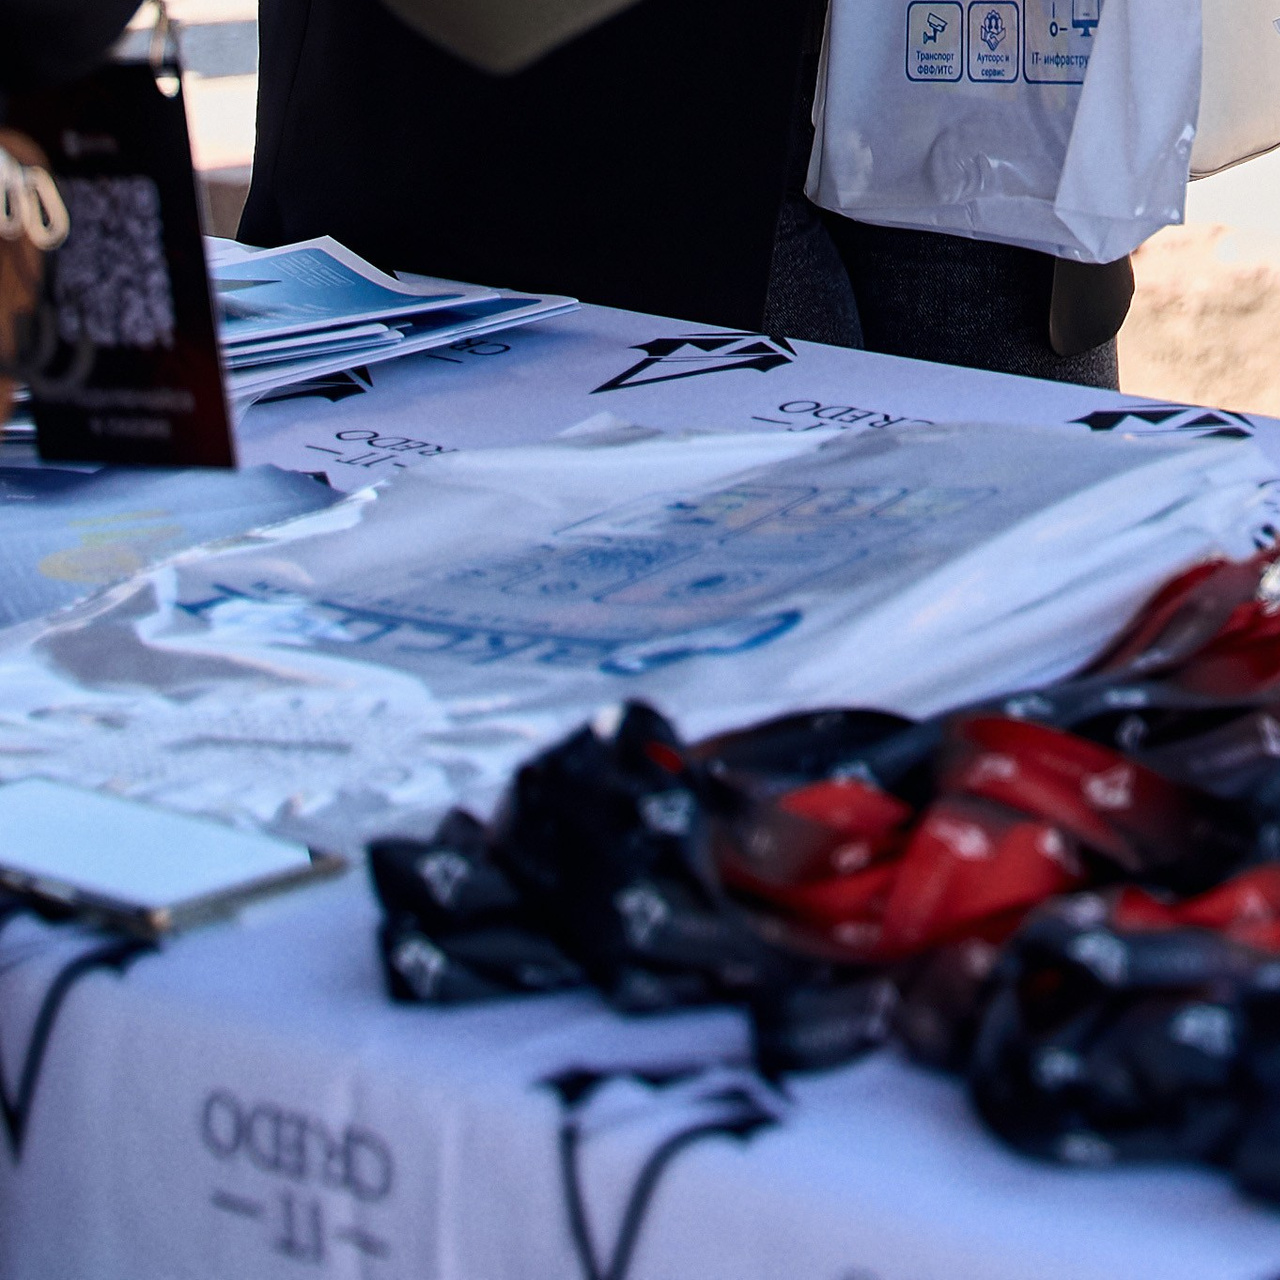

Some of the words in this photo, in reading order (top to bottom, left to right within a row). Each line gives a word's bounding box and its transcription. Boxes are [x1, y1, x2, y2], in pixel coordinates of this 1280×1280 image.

[916, 50, 955, 63] Транспорт
[976, 52, 1005, 64] Аутсорс
[1043, 52, 1090, 69] инфрастру
[916, 64, 953, 75] ФВФ/ИТС
[981, 68, 1005, 77] сервис
[335, 429, 461, 457] REDO
